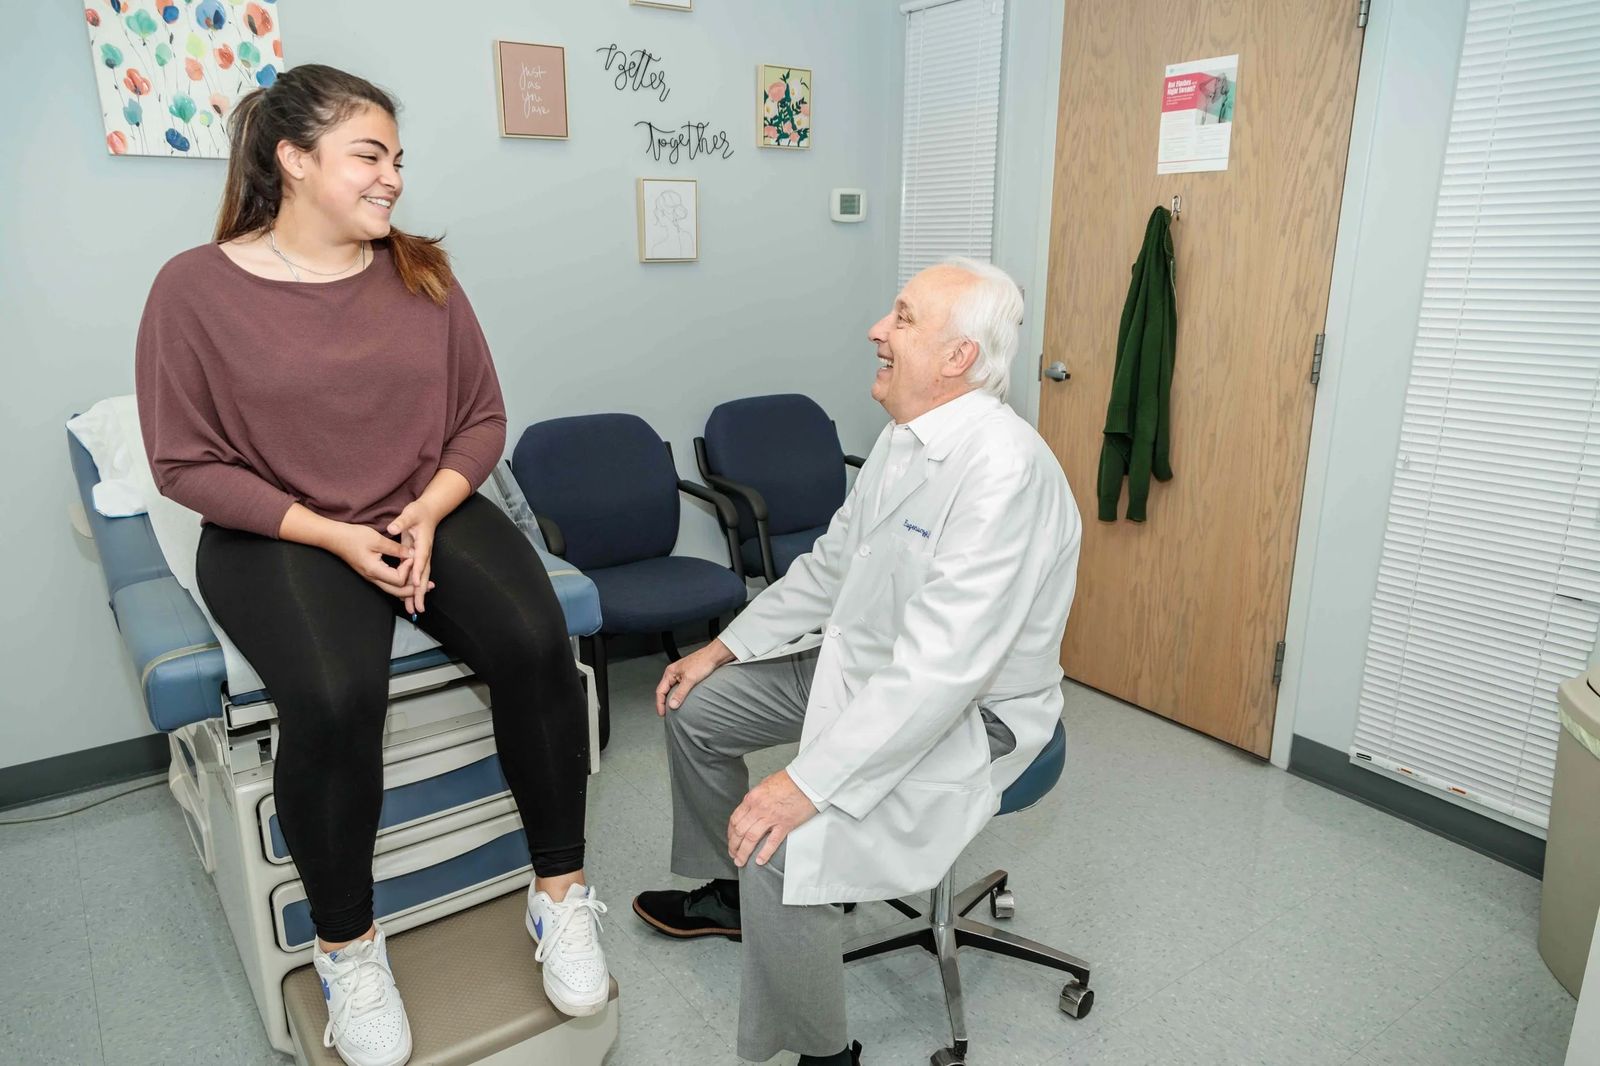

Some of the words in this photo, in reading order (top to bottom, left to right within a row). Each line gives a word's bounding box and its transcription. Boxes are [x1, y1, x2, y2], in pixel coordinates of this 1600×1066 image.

[527, 81, 541, 89] as
[596, 43, 671, 103] Better
[531, 105, 550, 116] are
[634, 120, 735, 165] Together
